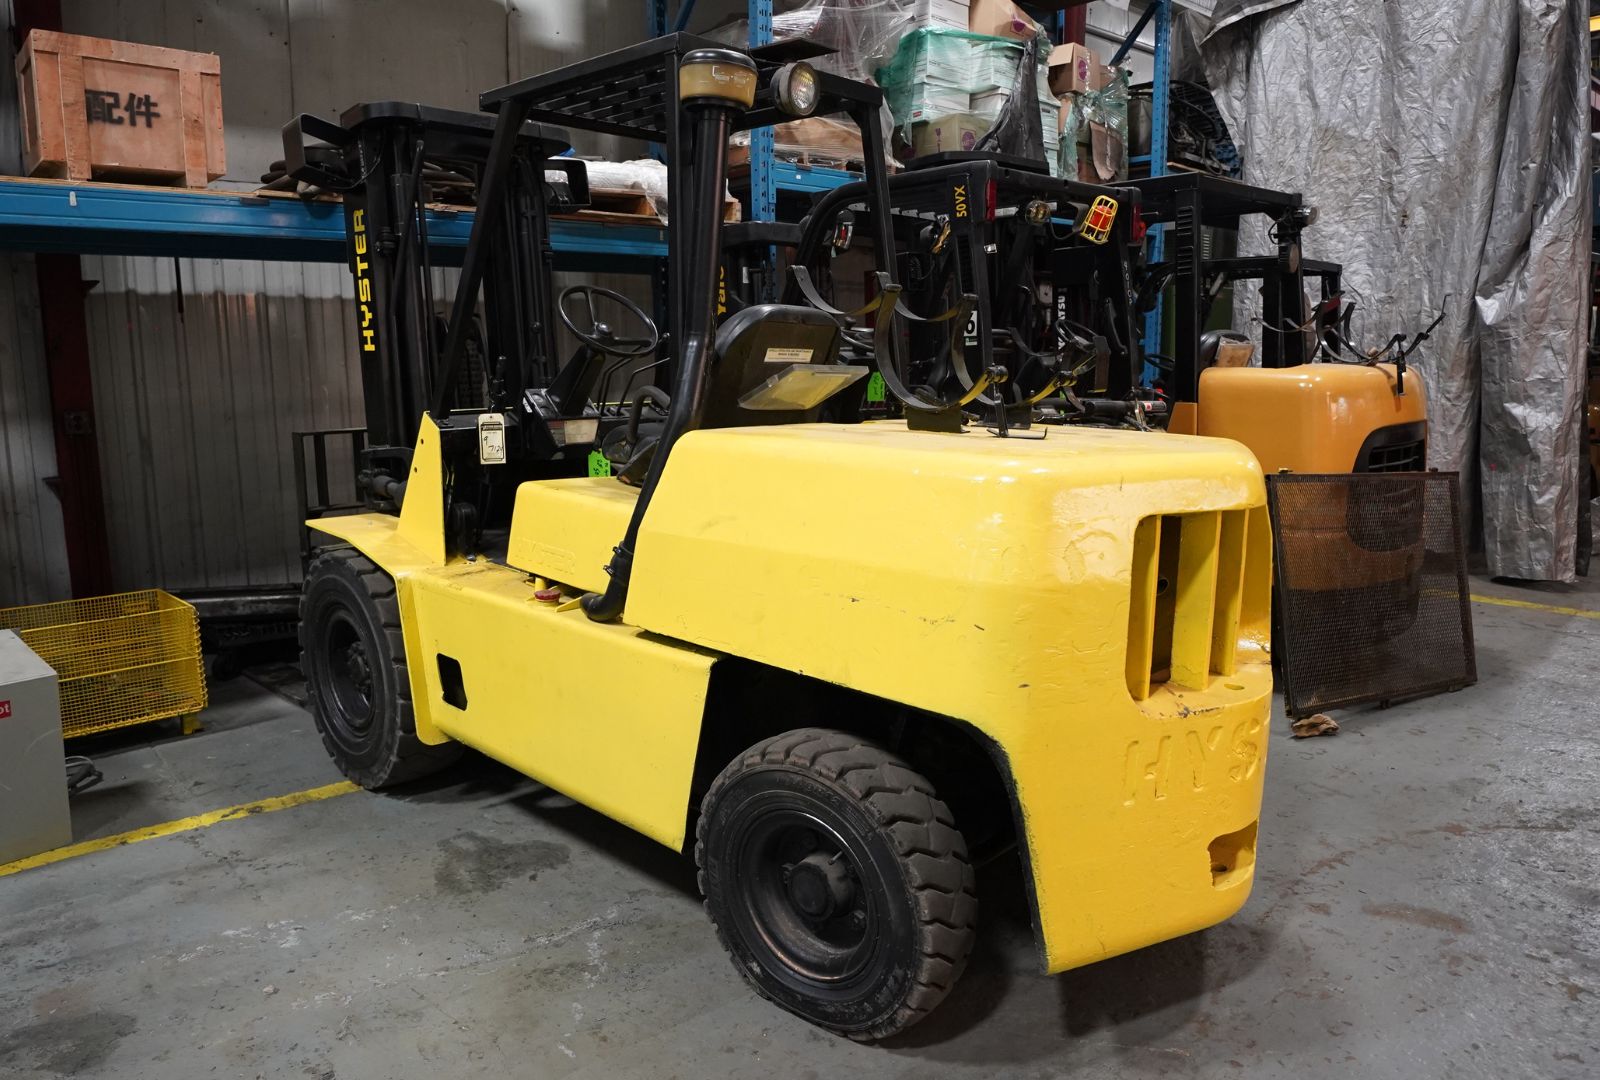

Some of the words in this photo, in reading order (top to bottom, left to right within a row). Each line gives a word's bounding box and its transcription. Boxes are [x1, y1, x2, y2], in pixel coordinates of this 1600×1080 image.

[85, 88, 161, 128] 配件
[954, 184, 967, 218] 50VX
[353, 208, 376, 352] HYSTER
